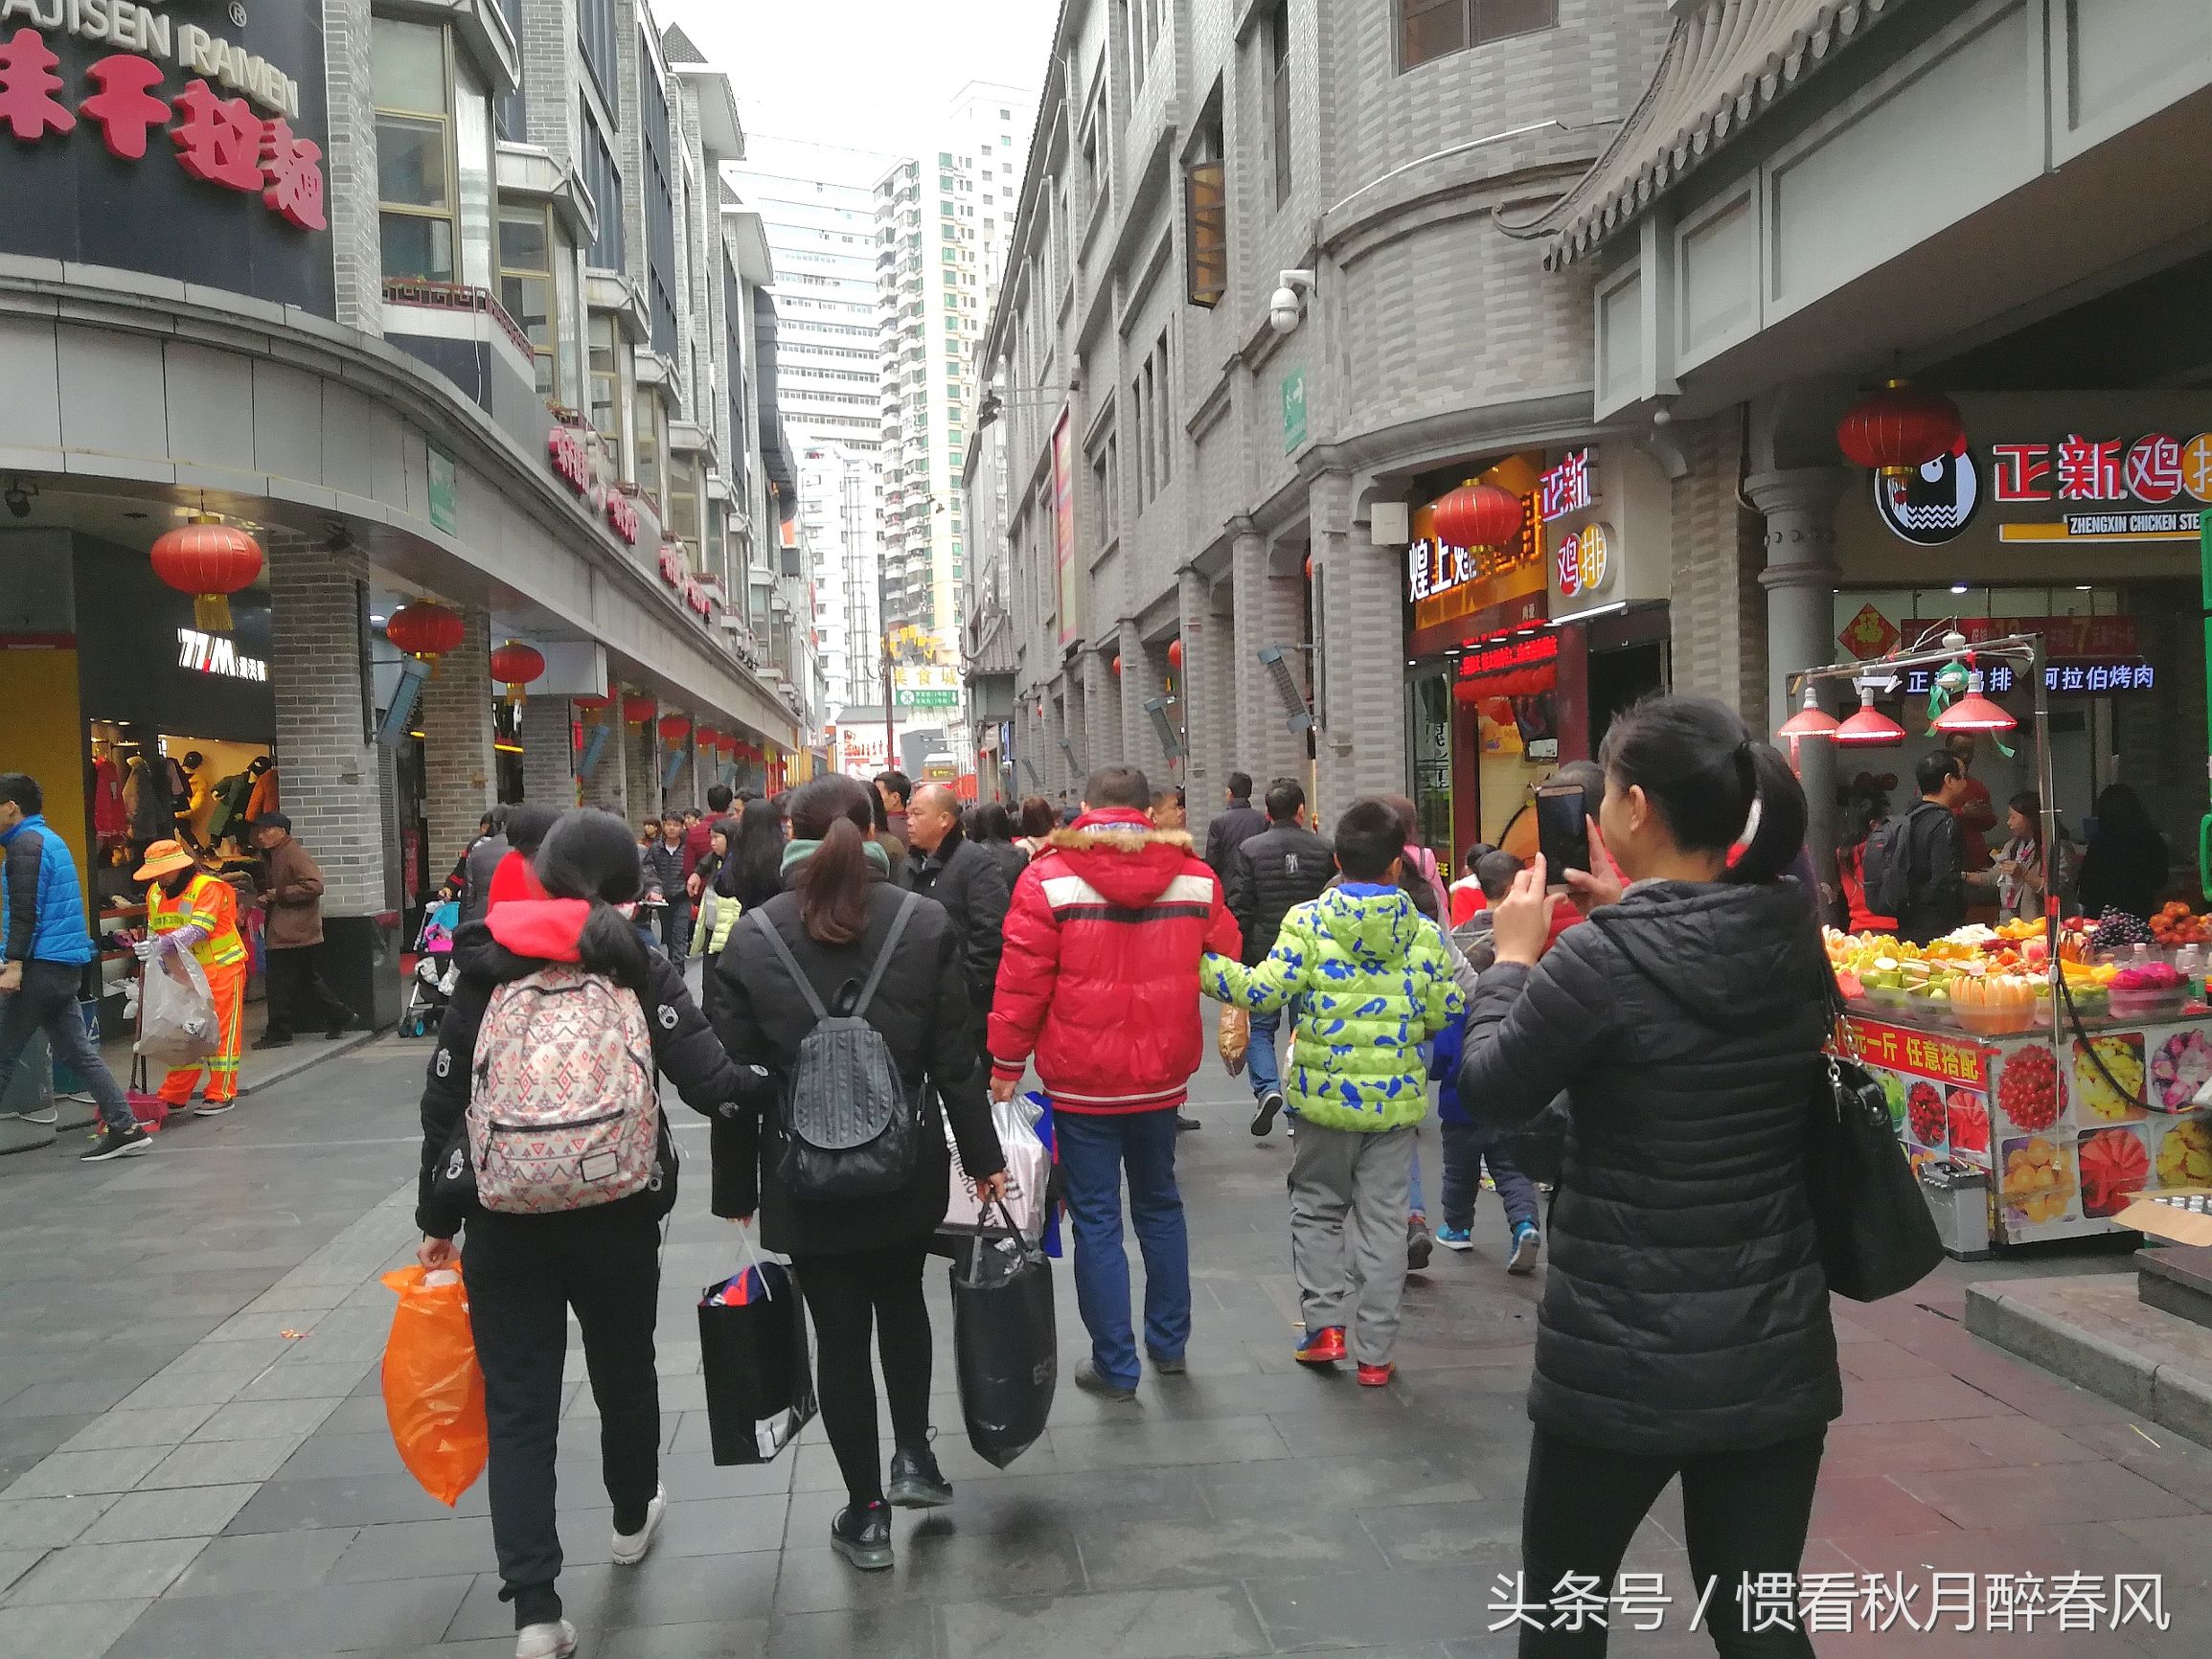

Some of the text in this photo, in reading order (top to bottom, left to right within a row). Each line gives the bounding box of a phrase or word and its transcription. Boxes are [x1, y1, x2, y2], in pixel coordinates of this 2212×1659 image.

[1, 0, 300, 119] AJISEN RAMEN
[1540, 446, 1591, 522] 正新
[2070, 515, 2127, 534] ZHENGXIN
[2130, 513, 2177, 532] CHICKEN
[1558, 527, 1607, 587] 鸡排
[1906, 667, 2012, 693] 正排
[1906, 1035, 1979, 1081] 任意搭配
